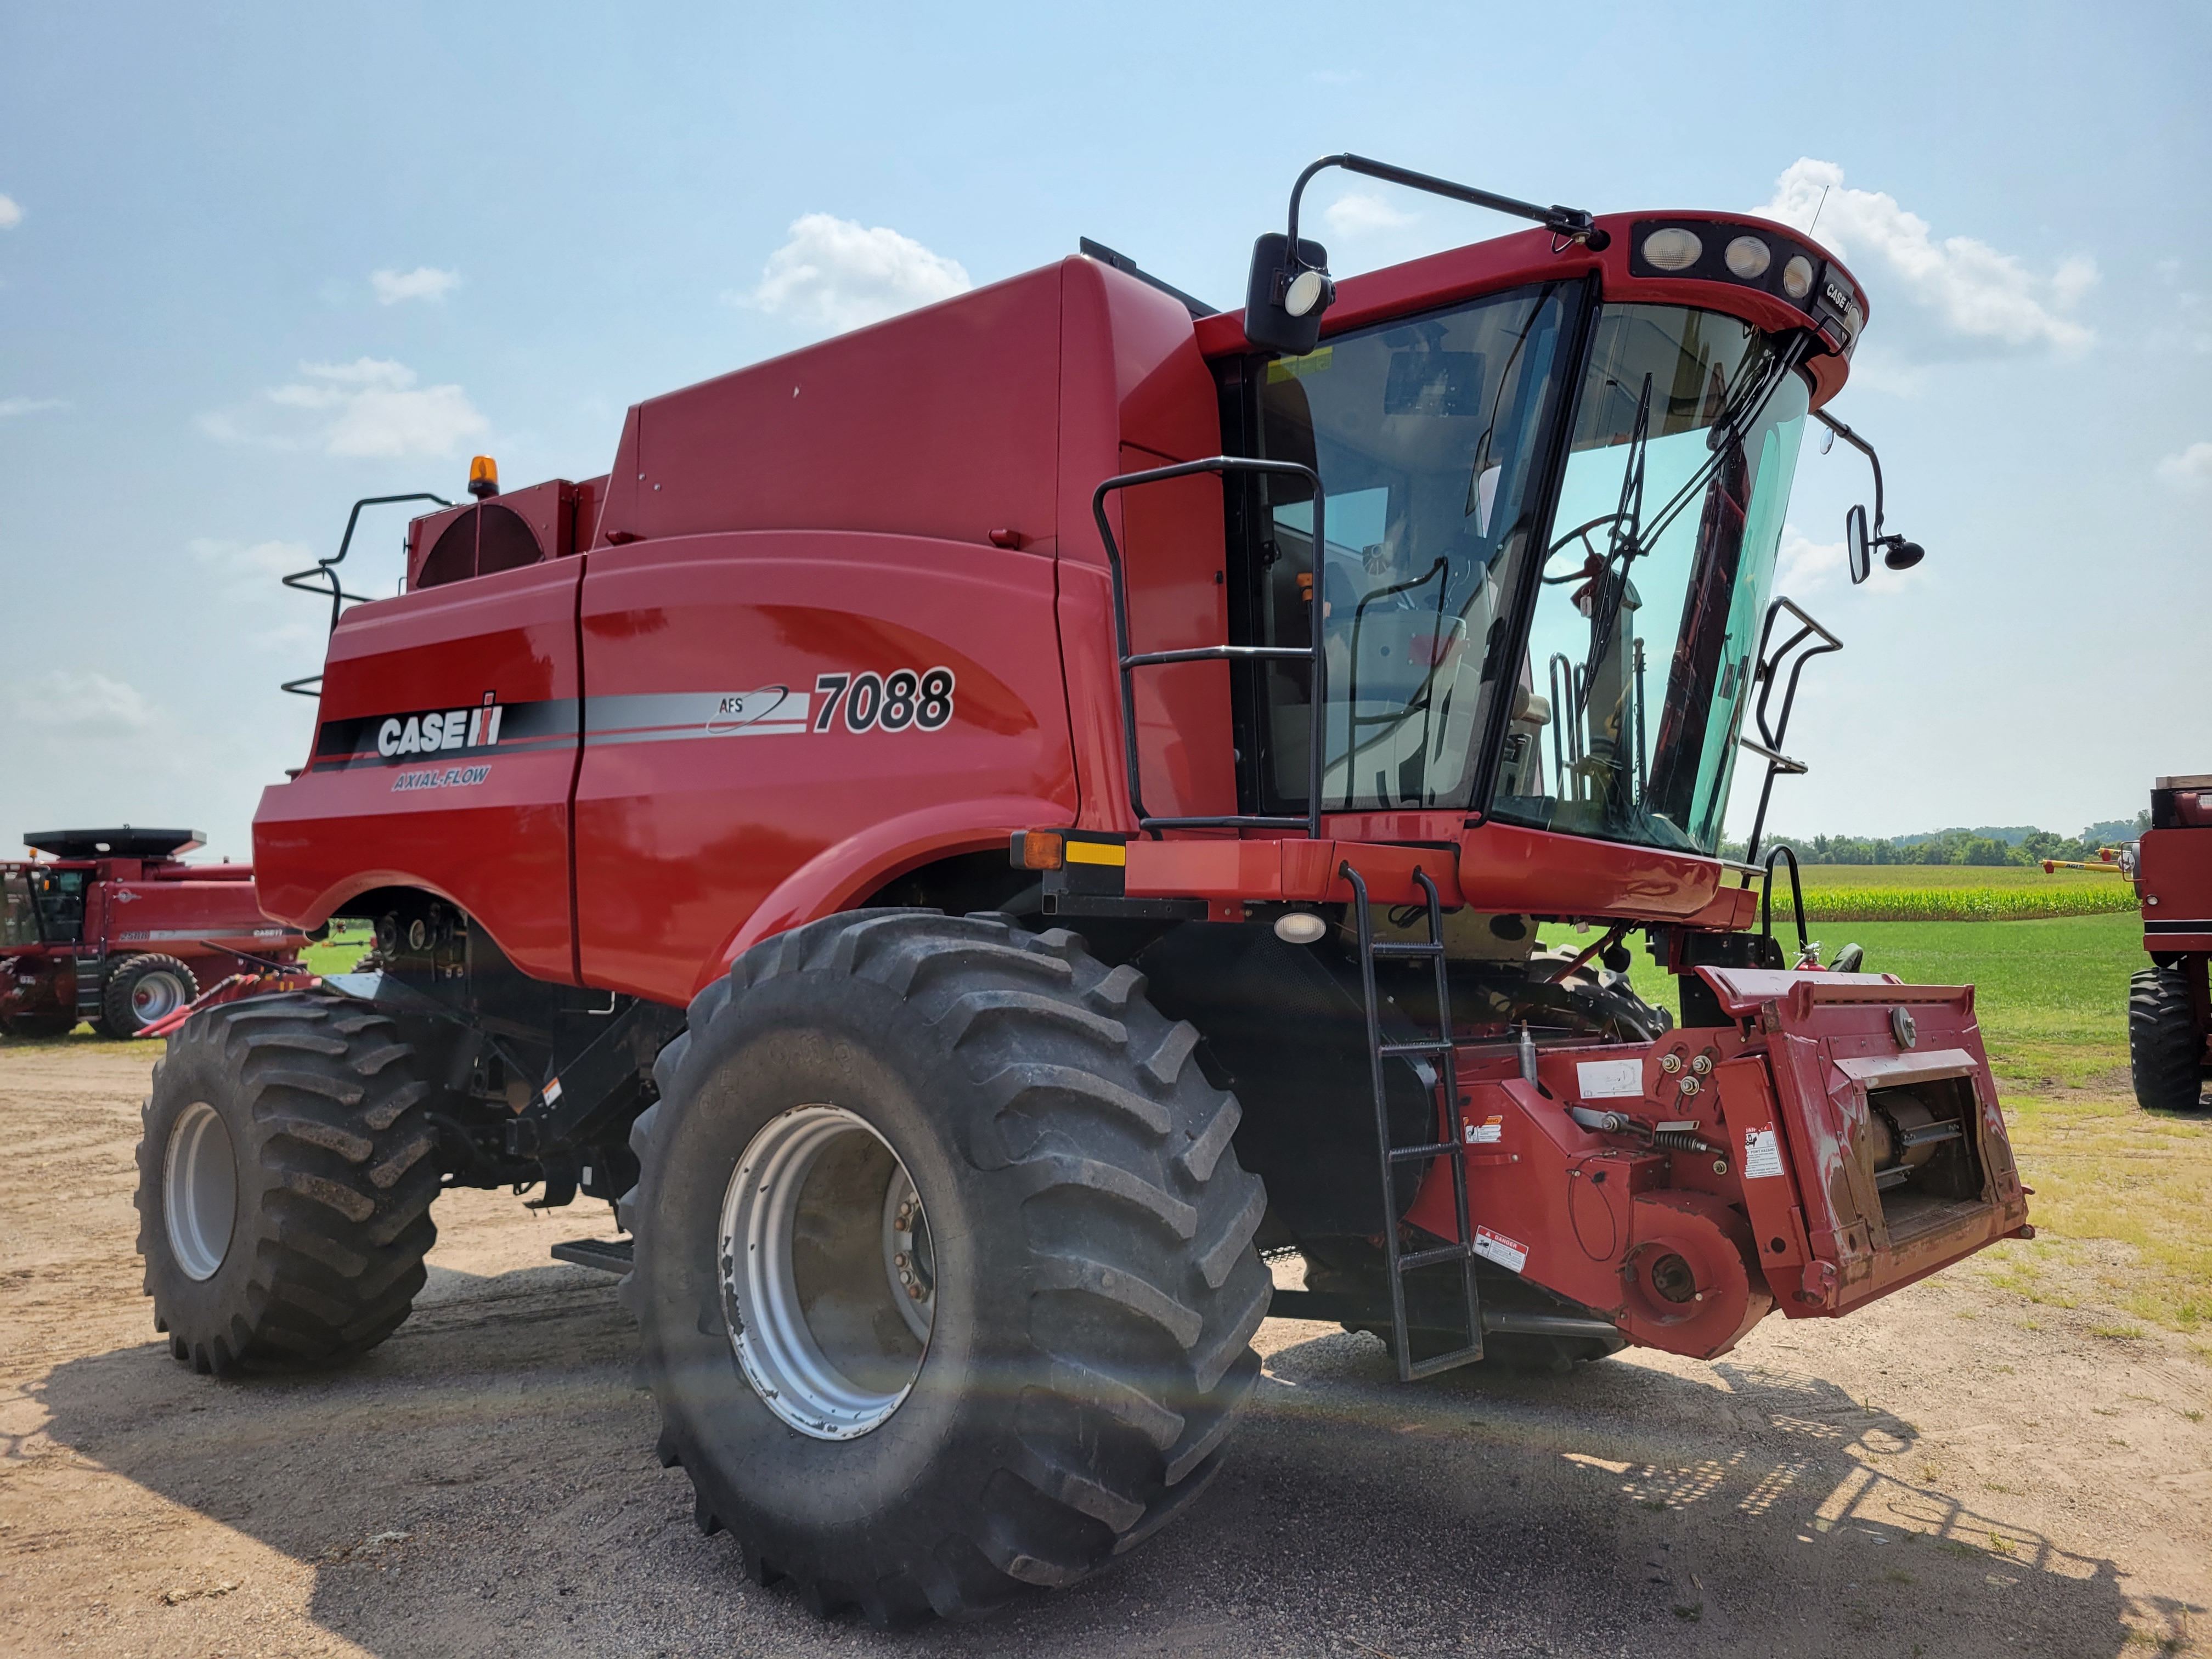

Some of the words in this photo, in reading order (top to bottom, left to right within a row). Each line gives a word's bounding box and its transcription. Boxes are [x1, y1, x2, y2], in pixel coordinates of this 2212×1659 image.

[1826, 284, 1847, 309] CASE
[719, 697, 743, 713] AFS
[813, 665, 956, 734] 7088
[377, 710, 468, 757] CASE
[391, 765, 492, 792] AXIAL-FLOW
[1494, 1234, 1517, 1249] DANGER
